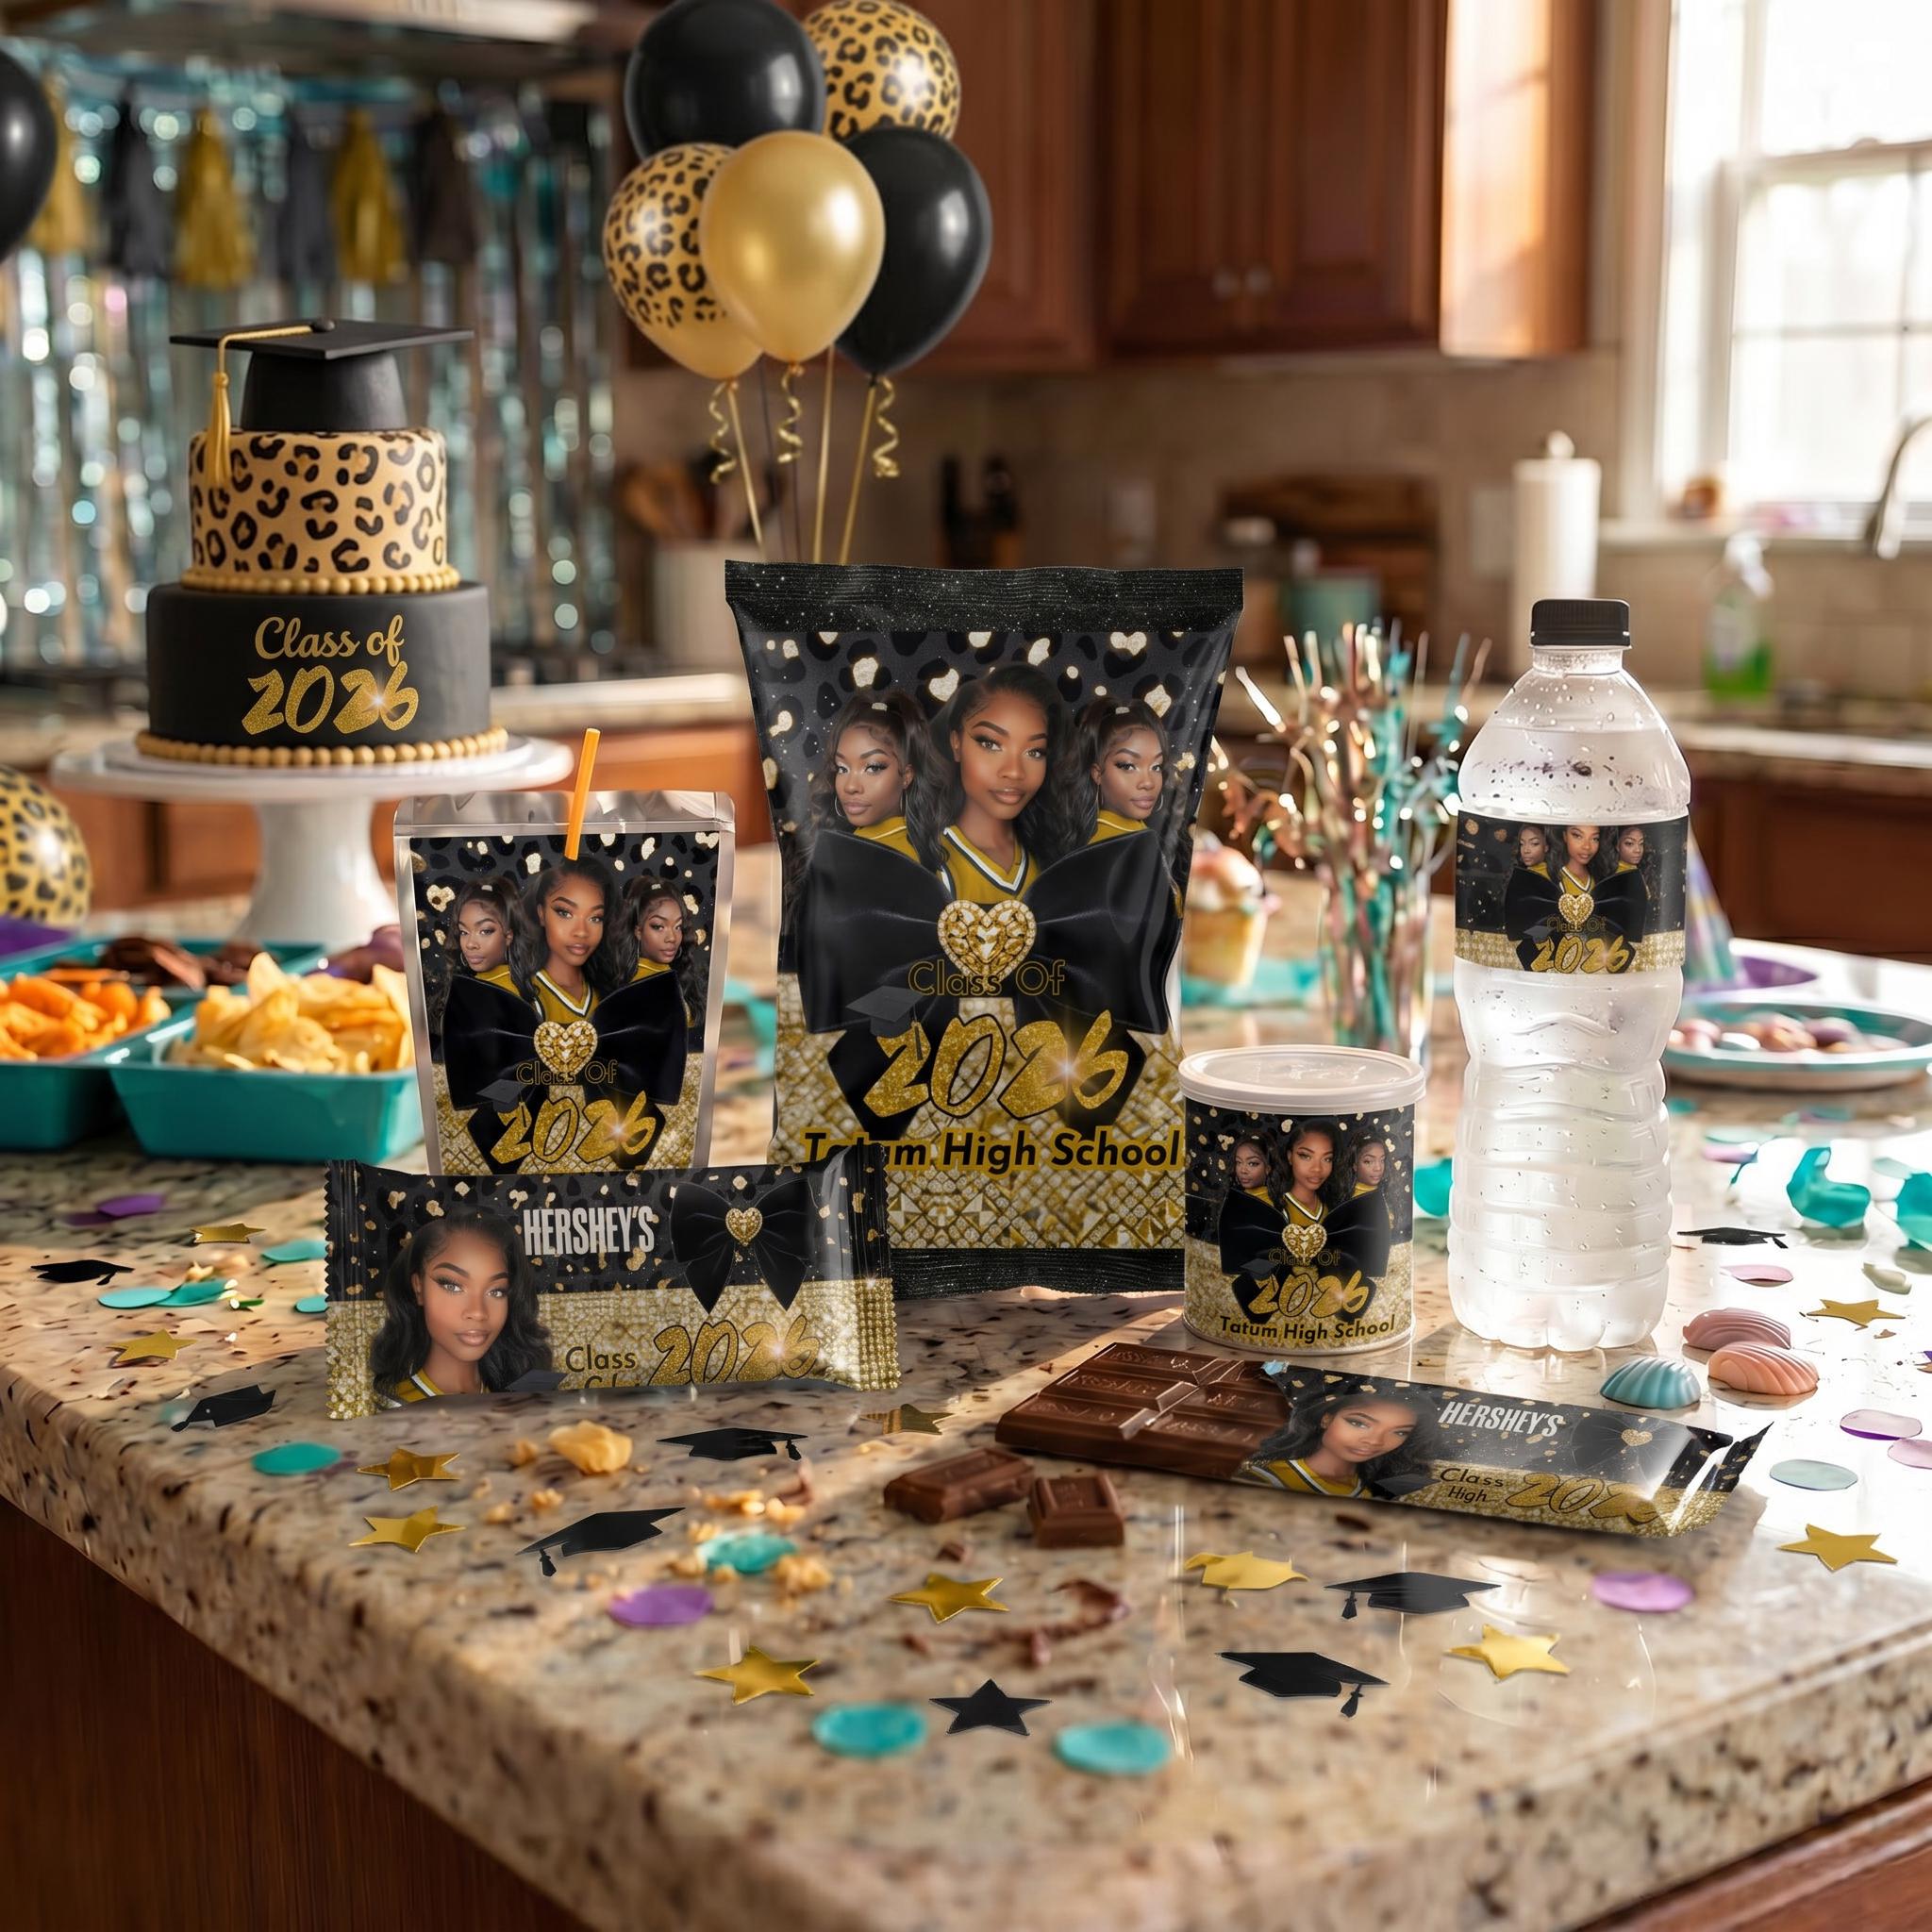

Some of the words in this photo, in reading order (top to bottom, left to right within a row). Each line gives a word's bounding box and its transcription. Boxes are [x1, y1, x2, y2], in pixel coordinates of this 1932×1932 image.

[255, 616, 360, 659] Class
[366, 614, 405, 667] of
[242, 660, 419, 735] 2026
[908, 958, 1001, 996] Class
[1015, 959, 1066, 996] Of
[1531, 935, 1629, 974] 2026
[516, 1060, 575, 1085] Class
[585, 1058, 619, 1084] Of
[863, 1009, 1129, 1120] 2026
[490, 1090, 657, 1164] 2026
[942, 1129, 1037, 1174] High
[1051, 1129, 1183, 1166] School
[523, 1206, 655, 1256] HERSHEY'S
[1248, 1270, 1370, 1318] 2026
[566, 1343, 637, 1373] Class
[647, 1314, 821, 1385] 2026
[1220, 1316, 1277, 1339] Tatum
[1284, 1323, 1327, 1344] High
[1334, 1314, 1395, 1339] School
[1438, 1401, 1563, 1437] HERSHEY'S
[1440, 1467, 1505, 1488] Class
[1447, 1485, 1488, 1504] High
